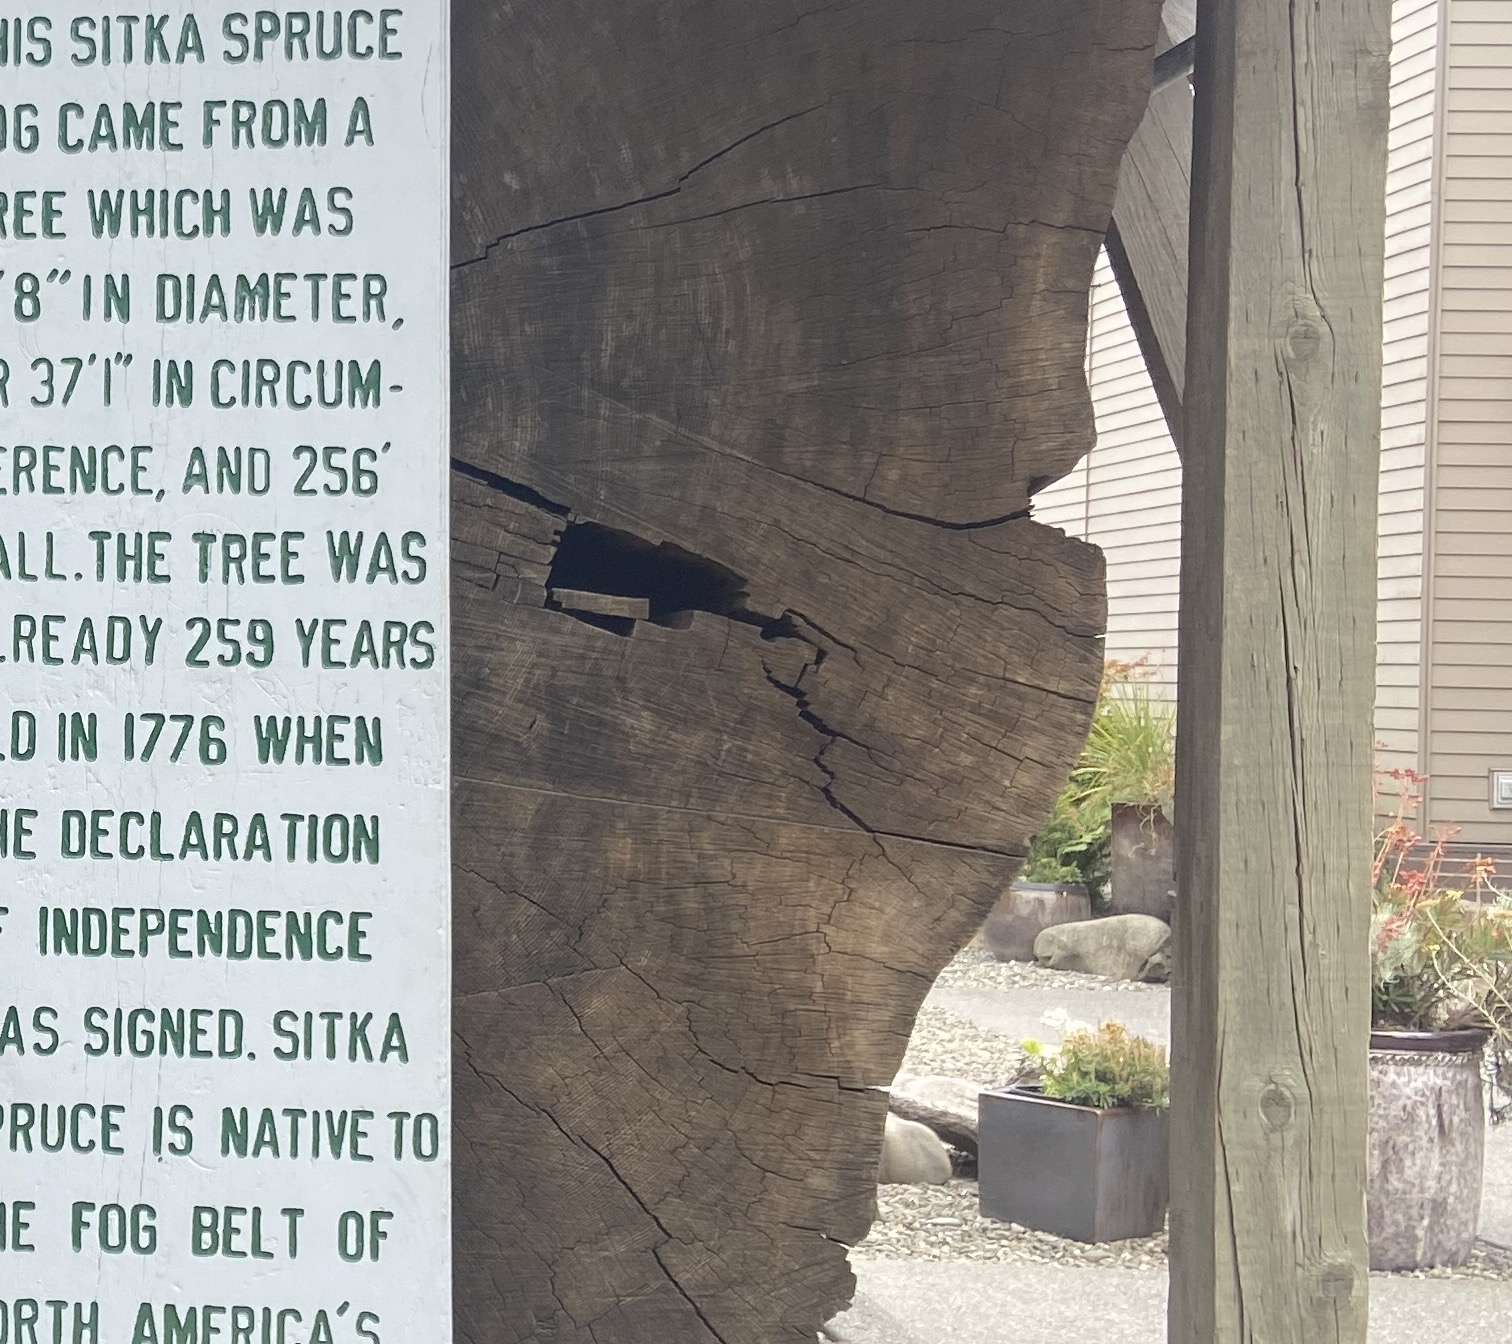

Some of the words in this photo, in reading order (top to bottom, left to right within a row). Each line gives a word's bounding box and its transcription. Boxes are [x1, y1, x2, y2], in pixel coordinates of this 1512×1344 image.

[70, 14, 206, 66] SITKA
[222, 8, 404, 64] SPRUCE
[57, 101, 184, 154] CAME
[202, 98, 327, 150] FROM
[344, 97, 375, 147] A
[87, 188, 232, 240] WHICH
[249, 187, 354, 237] WAS
[82, 274, 130, 324] IN
[156, 272, 406, 331] DIAMETER,
[152, 358, 194, 407] IN
[209, 358, 404, 410] CIRCUM-
[182, 446, 271, 496] AND
[192, 531, 306, 585] TREE
[326, 530, 427, 585] WAS
[184, 617, 274, 668] 259
[294, 618, 436, 671] YEARS
[58, 712, 97, 762] IN
[124, 714, 227, 765] 1776
[254, 715, 383, 767] WHEN
[61, 809, 380, 865] DECLARATION
[39, 906, 374, 962] INDEPENDENCE
[83, 1007, 257, 1061] SIGNED.
[273, 1010, 410, 1064] SITKA
[152, 1103, 193, 1158] IS
[221, 1107, 375, 1162] NATIVE
[389, 1111, 440, 1162] TO
[71, 1202, 157, 1256] FOG
[191, 1205, 306, 1260] BELT
[338, 1209, 395, 1263] OF
